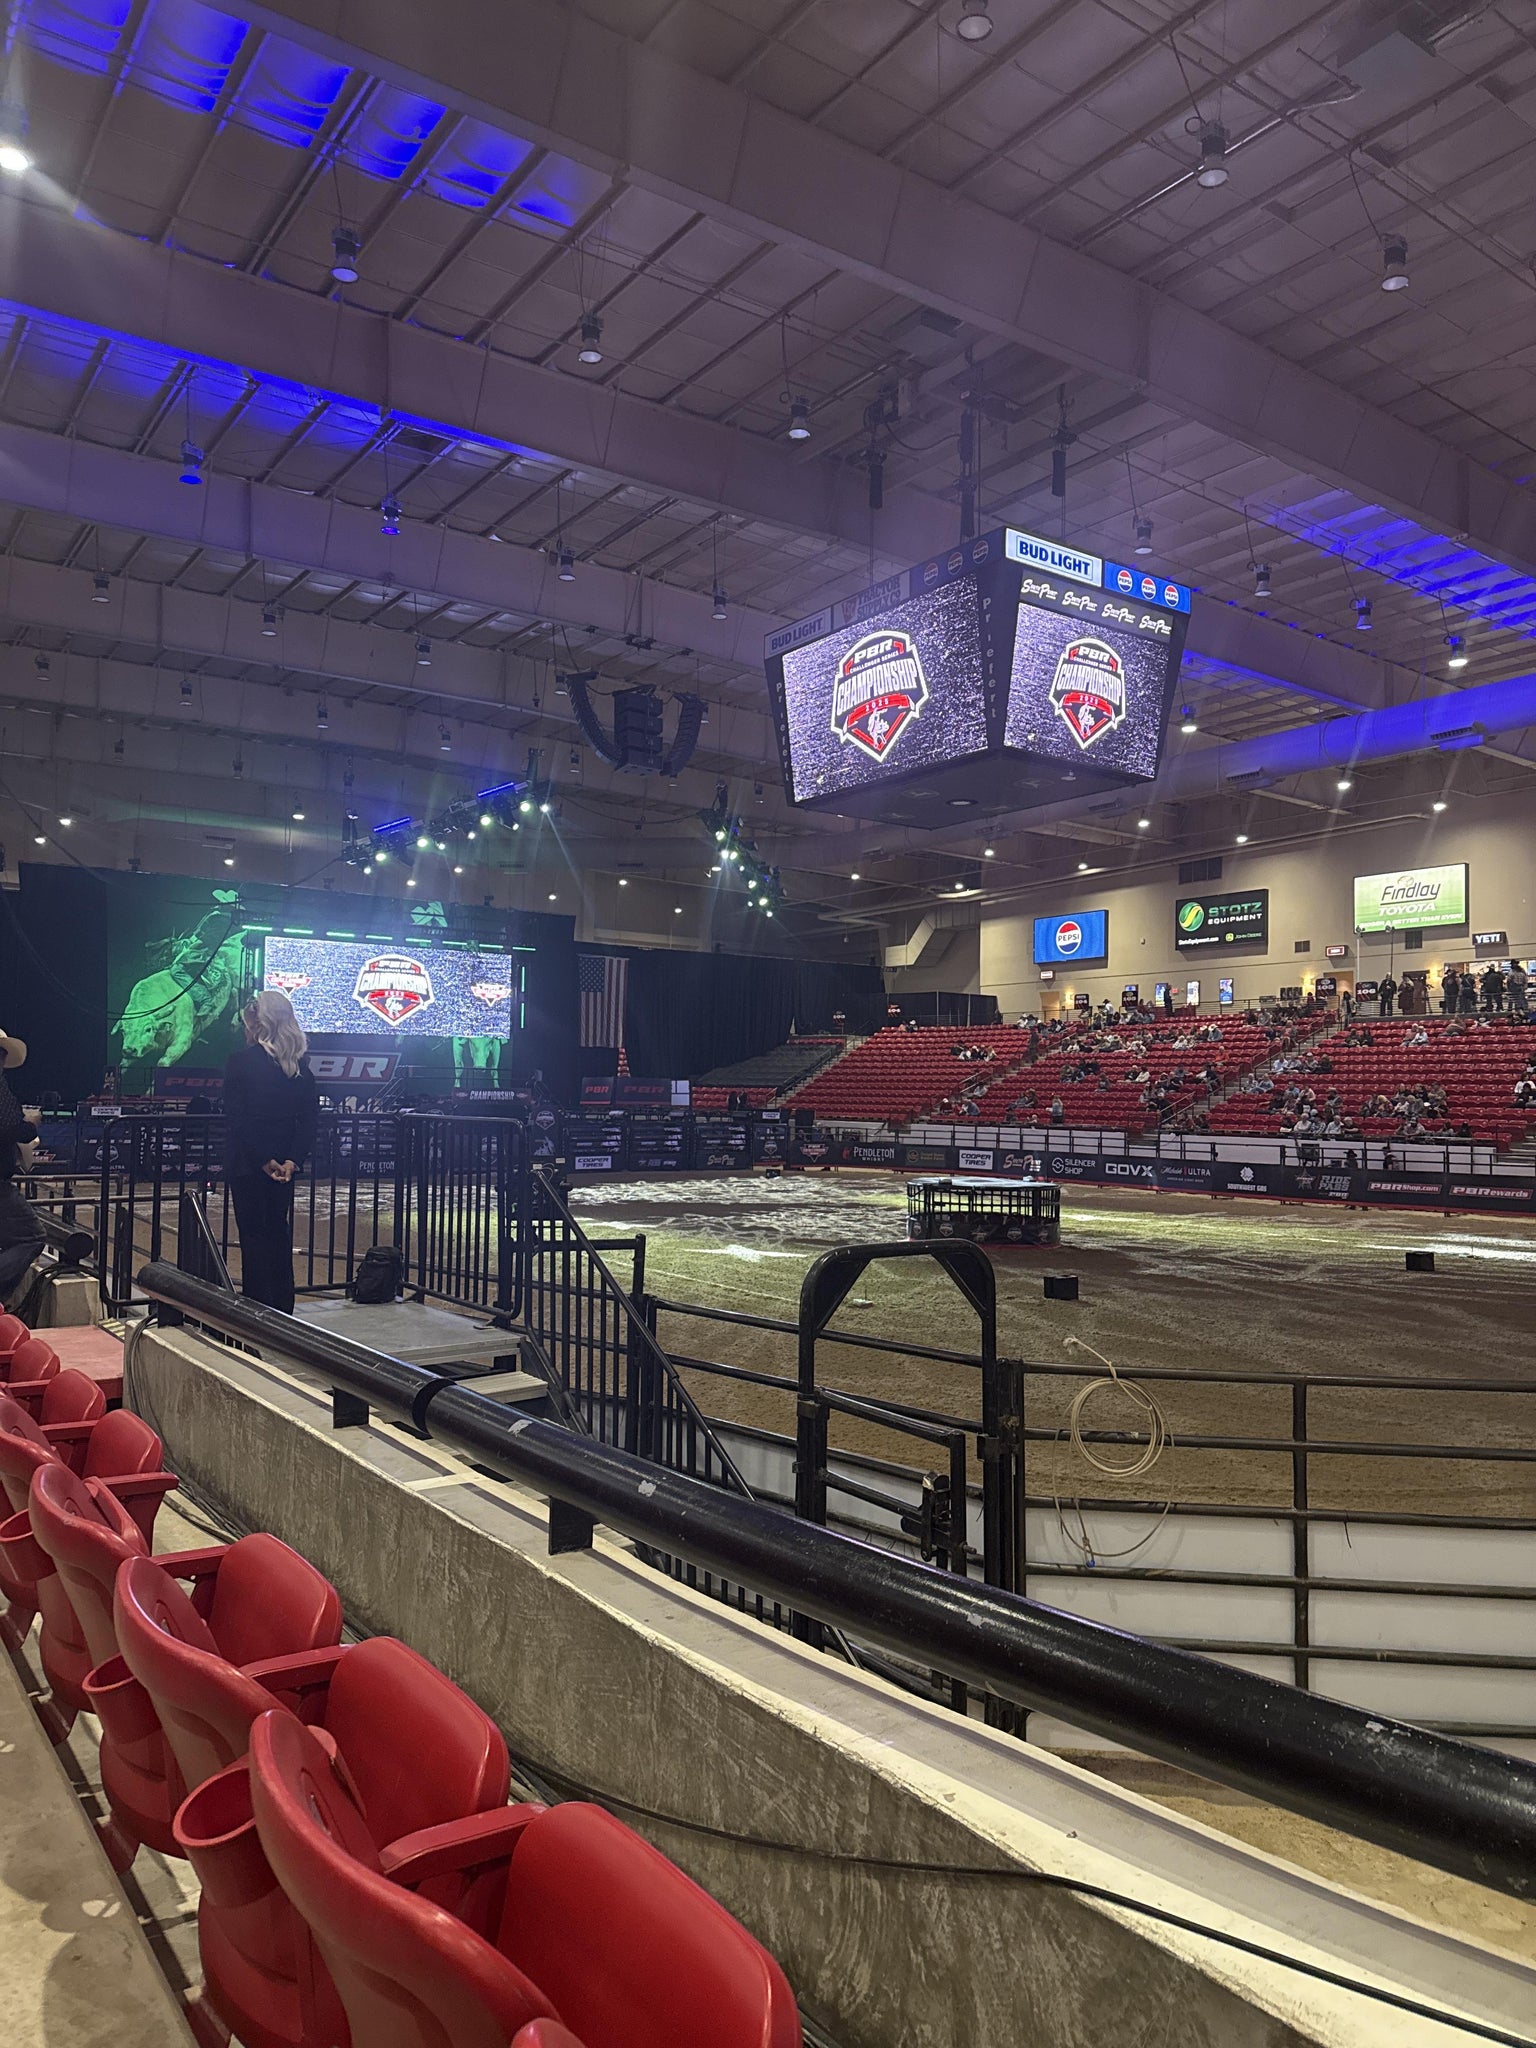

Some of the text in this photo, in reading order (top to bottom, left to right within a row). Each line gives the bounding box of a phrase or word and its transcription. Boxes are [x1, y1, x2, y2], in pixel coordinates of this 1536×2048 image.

[1019, 540, 1091, 576] BUD LIGHT
[1118, 577, 1132, 586] PEPSI
[1142, 584, 1155, 593] PEPSI
[1165, 592, 1178, 600] PEPSI
[771, 616, 824, 651] BUD LIGHT
[854, 639, 893, 664] PBR
[1078, 645, 1110, 663] PBR
[849, 650, 899, 674] CHALLENGER SERIES
[836, 657, 918, 716] CHAMPIONSHIP
[1056, 663, 1122, 706] CHAMPIONSHIP
[865, 697, 889, 712] 2025
[1381, 881, 1442, 901] Findlay
[1208, 902, 1263, 917] STOTZ
[1378, 902, 1436, 917] TOYOTA
[1207, 913, 1263, 925] EQUIPMENT
[1057, 933, 1080, 942] PEPSI
[1475, 934, 1501, 944] YETI
[307, 1055, 390, 1078] BR
[470, 1090, 515, 1101] CHAMPIONSHIP
[585, 1086, 609, 1094] PBR
[853, 1146, 895, 1159] PENDLETON
[961, 1152, 992, 1161] COOPER
[1064, 1158, 1096, 1168] SILENCER
[1064, 1166, 1083, 1175] SHOP
[1105, 1162, 1153, 1178] GOVX
[1187, 1167, 1212, 1177] ULTRA
[1320, 1174, 1352, 1184] RIDE
[1227, 1183, 1256, 1191] SOUTHWEST
[1318, 1182, 1350, 1192] PASS
[1370, 1182, 1440, 1192] PBRShop.com
[1452, 1186, 1530, 1198] PBRewards
